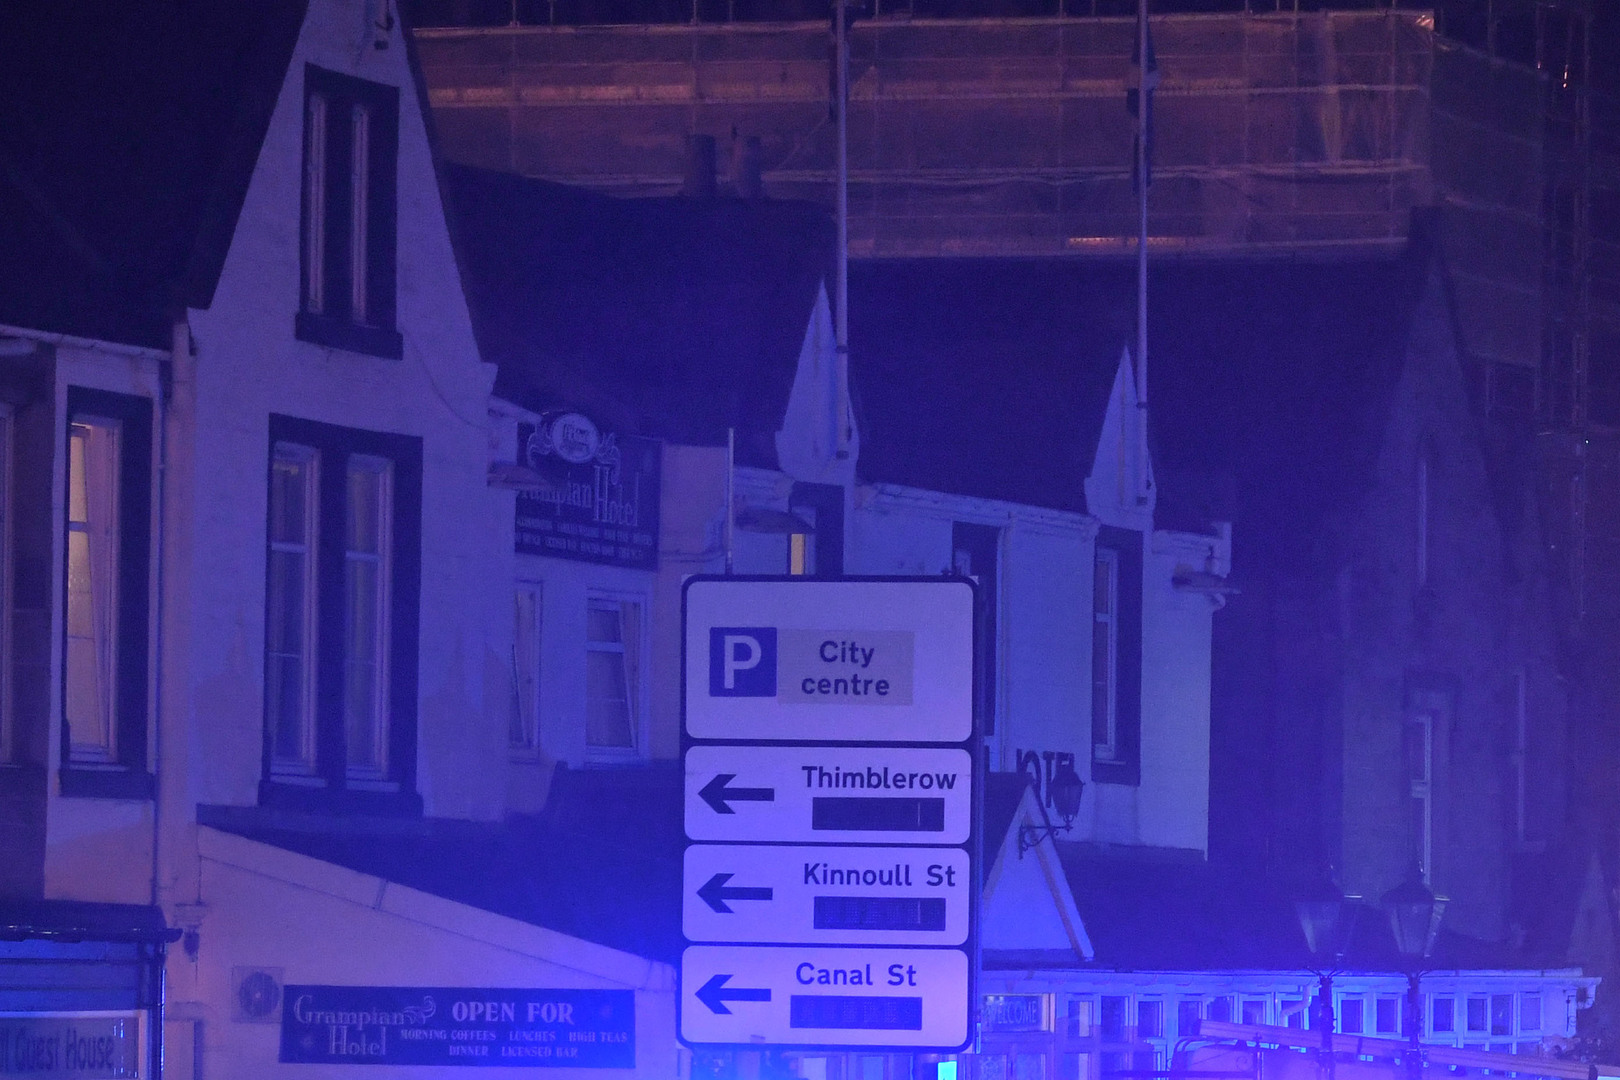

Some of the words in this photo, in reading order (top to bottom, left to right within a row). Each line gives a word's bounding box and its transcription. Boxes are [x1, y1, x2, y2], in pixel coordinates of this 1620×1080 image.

[593, 464, 640, 527] Hotel
[724, 635, 762, 690] P
[818, 640, 875, 668] City
[801, 674, 890, 696] centre
[801, 766, 957, 790] Thimblerow
[803, 863, 911, 887] Kinnoull
[926, 864, 956, 887] St
[795, 962, 873, 986] Canal
[887, 964, 917, 987] St
[293, 994, 404, 1031] Grampian
[452, 1001, 515, 1023] OPEN
[526, 1002, 575, 1026] FOR
[66, 1027, 114, 1071] House
[328, 1025, 387, 1056] Hotel
[400, 1029, 447, 1042] MORNING
[450, 1029, 497, 1042] COFFEES
[508, 1030, 556, 1043] LUNCHES
[569, 1031, 597, 1043] HIGH
[599, 1031, 628, 1044] TEAS
[448, 1044, 490, 1057] DINNER
[500, 1045, 552, 1058] LICENSED
[555, 1047, 579, 1059] BAR
